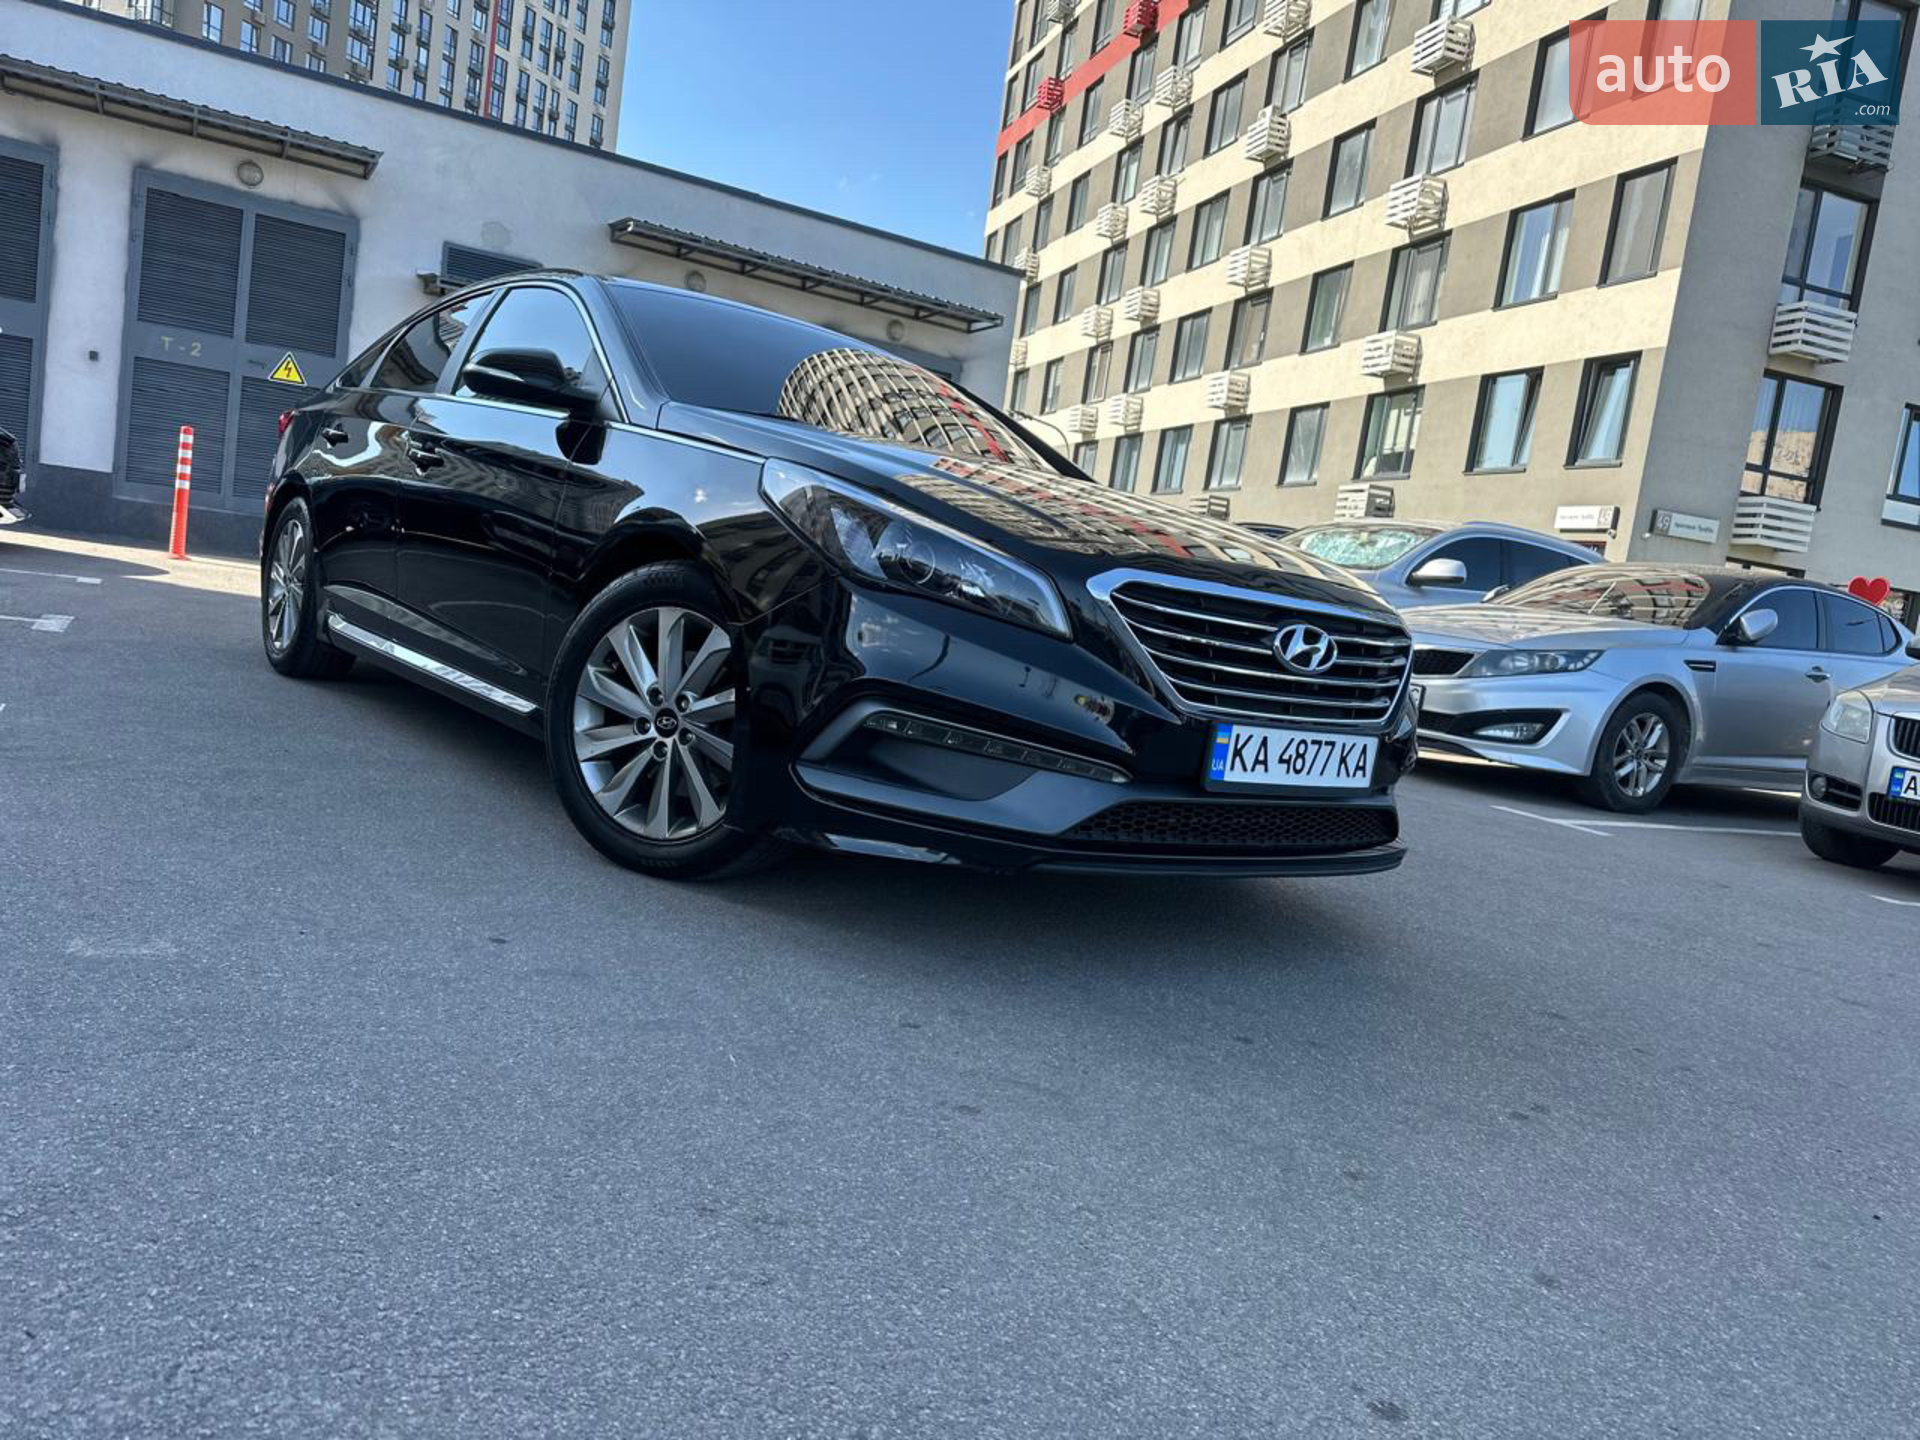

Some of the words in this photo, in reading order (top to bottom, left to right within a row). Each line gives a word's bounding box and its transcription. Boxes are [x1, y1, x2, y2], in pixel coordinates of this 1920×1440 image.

[1230, 733, 1269, 773] KA
[1277, 737, 1336, 776] 4877
[1336, 742, 1368, 778] KA
